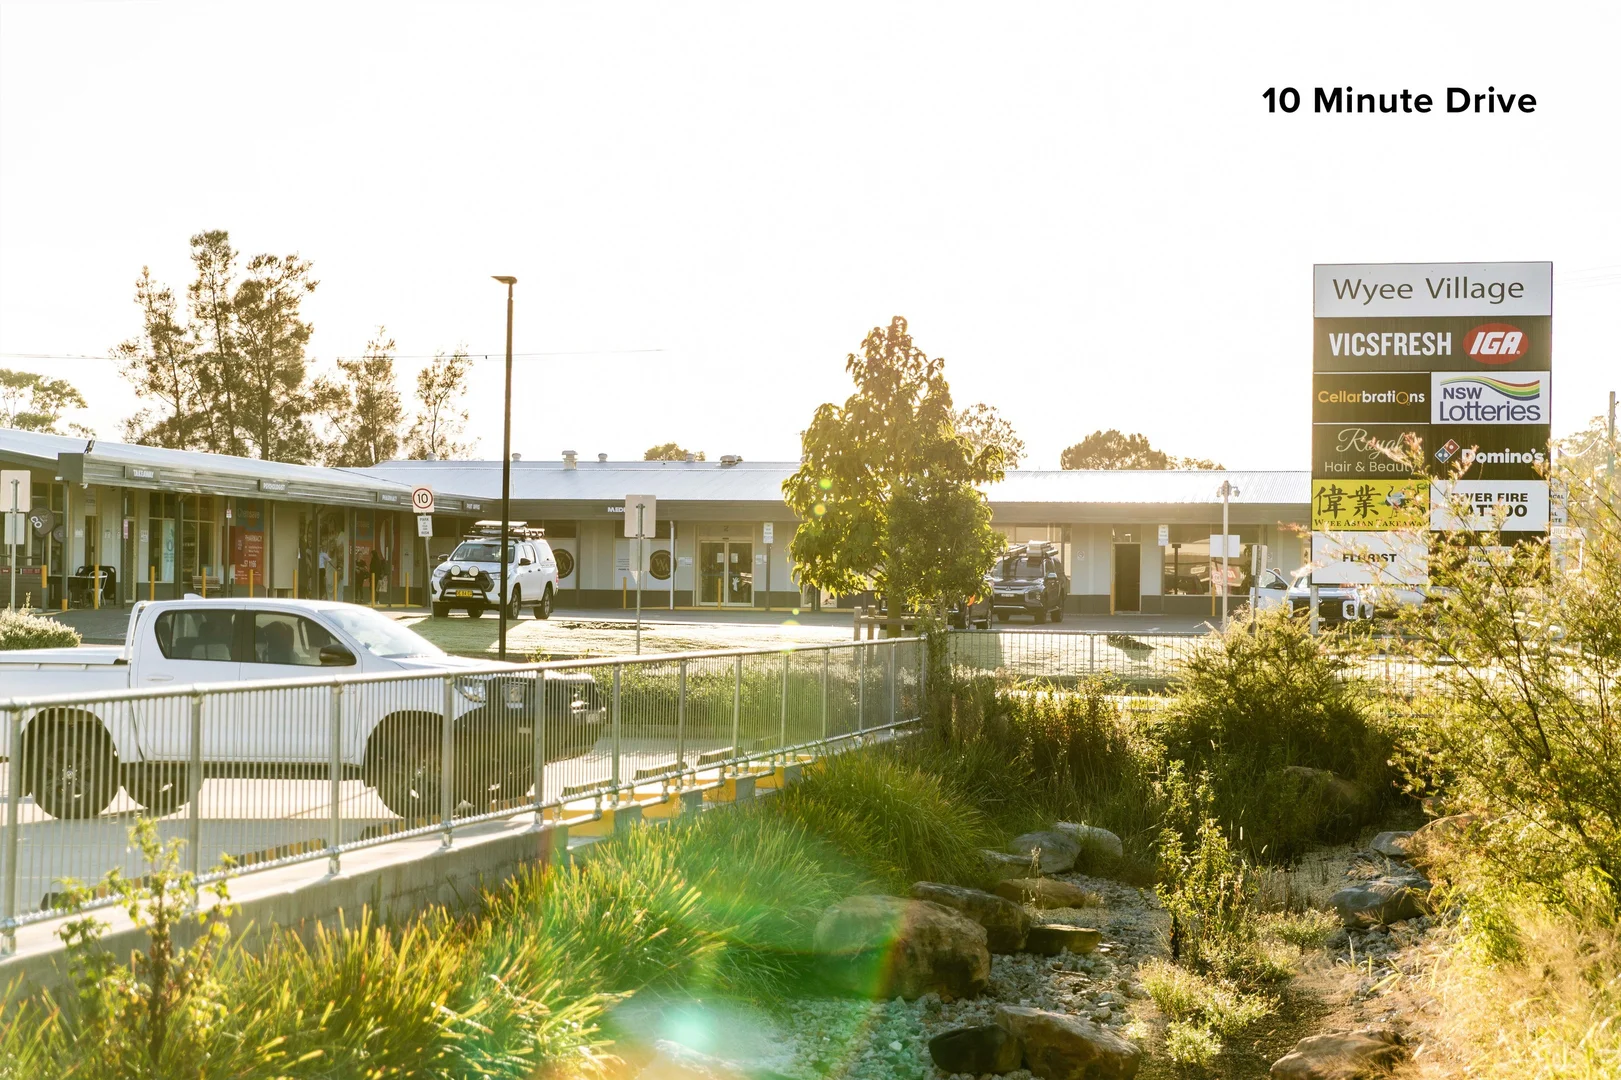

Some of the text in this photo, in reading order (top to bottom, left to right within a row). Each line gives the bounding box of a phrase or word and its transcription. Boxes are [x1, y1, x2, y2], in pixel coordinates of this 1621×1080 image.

[1333, 276, 1525, 306] Wyee Village
[1329, 331, 1523, 356] VICSFRESH IGA
[1317, 391, 1425, 405] Cellarbrations
[1443, 387, 1483, 400] NSW
[1440, 401, 1541, 422] Lotteries
[1461, 448, 1545, 464] Domino's
[1324, 461, 1352, 473] Hair
[1355, 461, 1366, 473] &
[417, 493, 429, 504] 10
[1313, 484, 1382, 519] 偉業
[1497, 493, 1529, 503] FIRE
[1344, 517, 1374, 527] ASIAN
